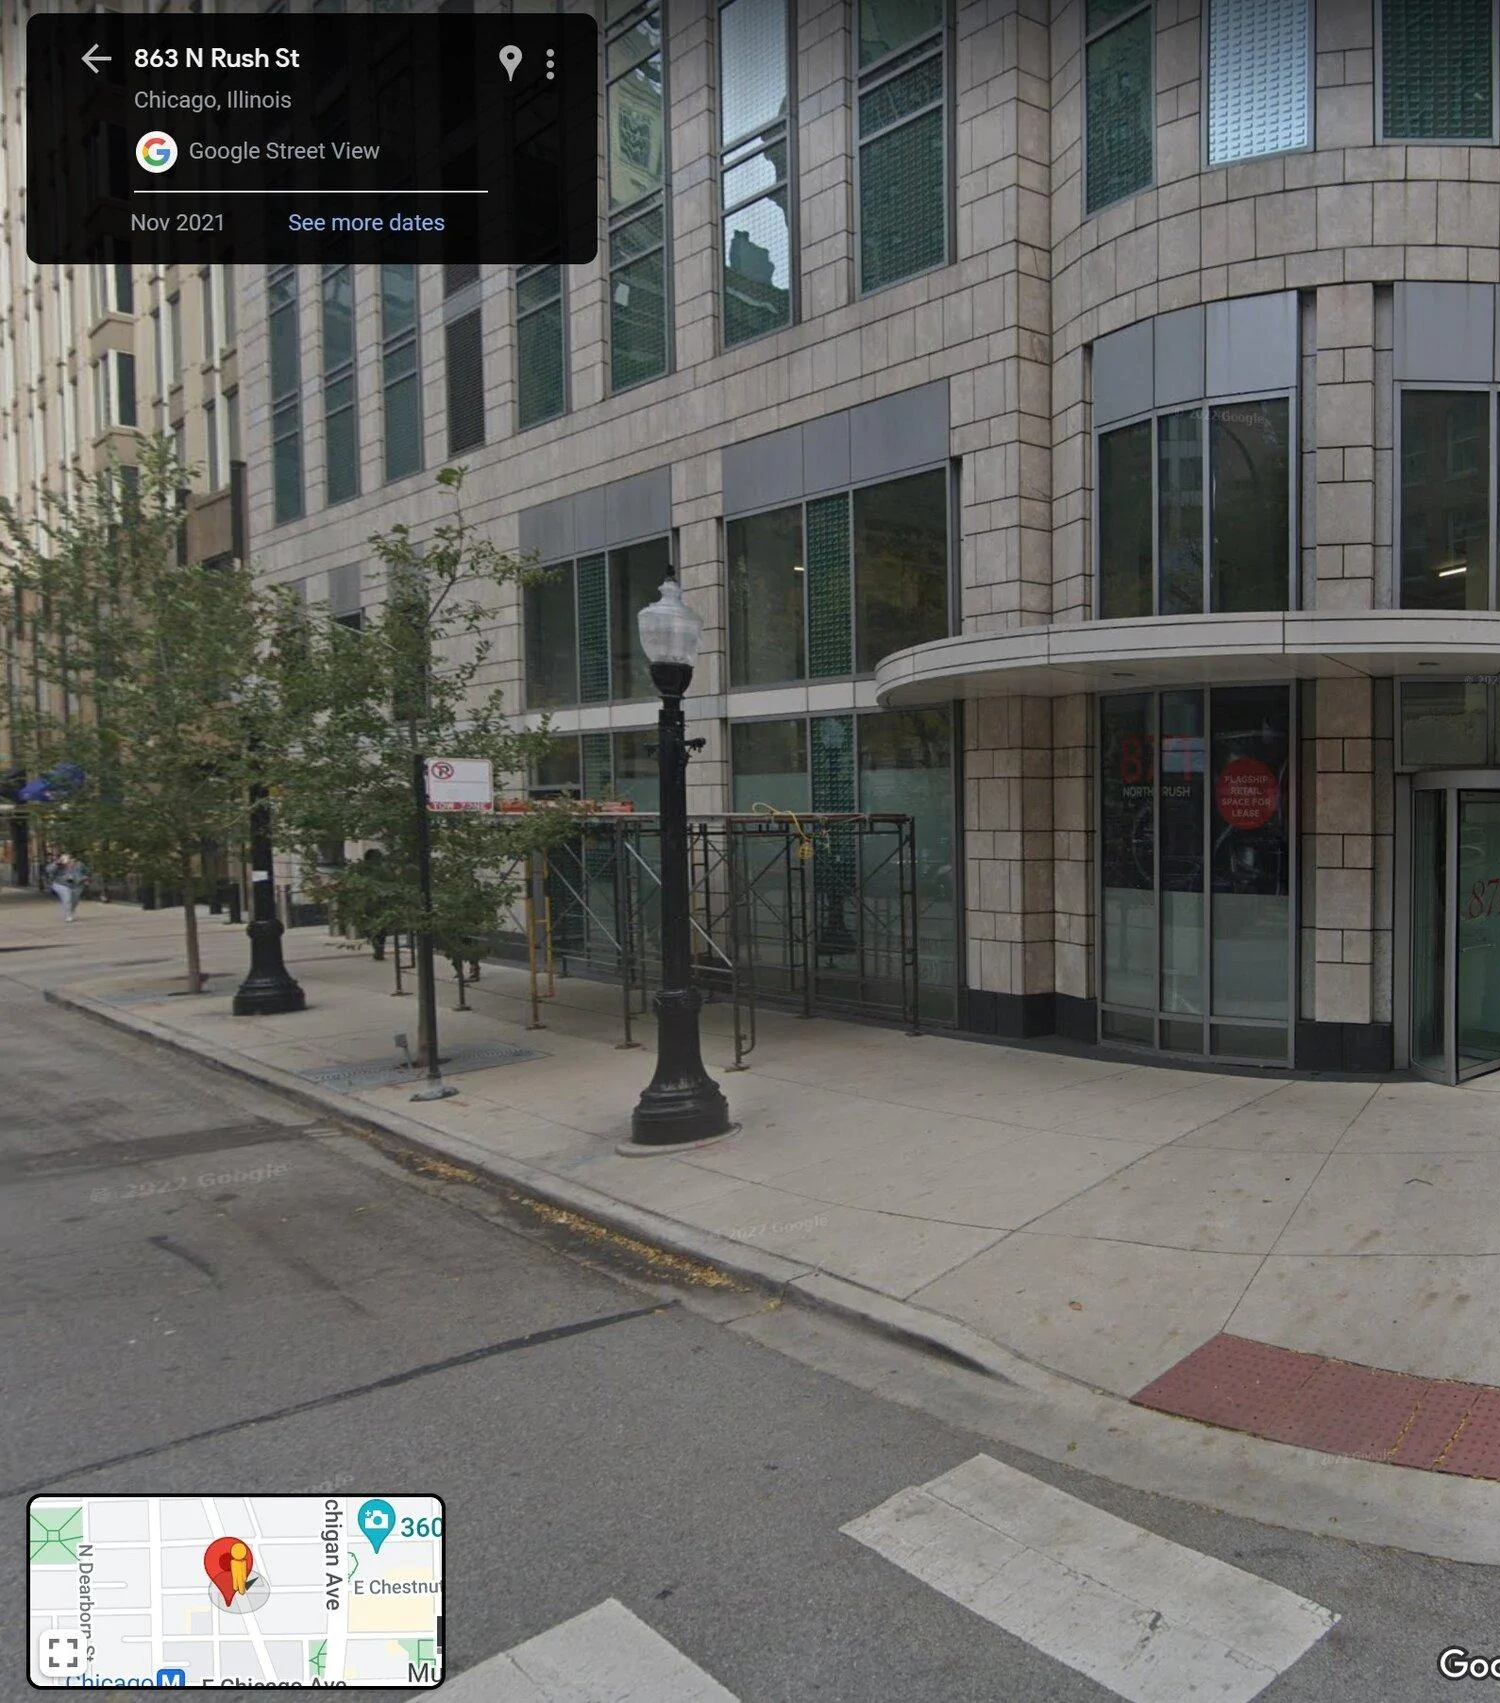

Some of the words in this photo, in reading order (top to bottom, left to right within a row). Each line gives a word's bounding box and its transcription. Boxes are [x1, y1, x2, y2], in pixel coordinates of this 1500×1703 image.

[1224, 775, 1270, 784] FLAGSHIP
[1122, 785, 1154, 799] NORTH
[1161, 785, 1191, 798] RUSH
[1230, 786, 1263, 796] RETAIL
[1221, 798, 1250, 807] SPACE
[1252, 798, 1272, 808] FOR
[1232, 808, 1260, 818] LEASE
